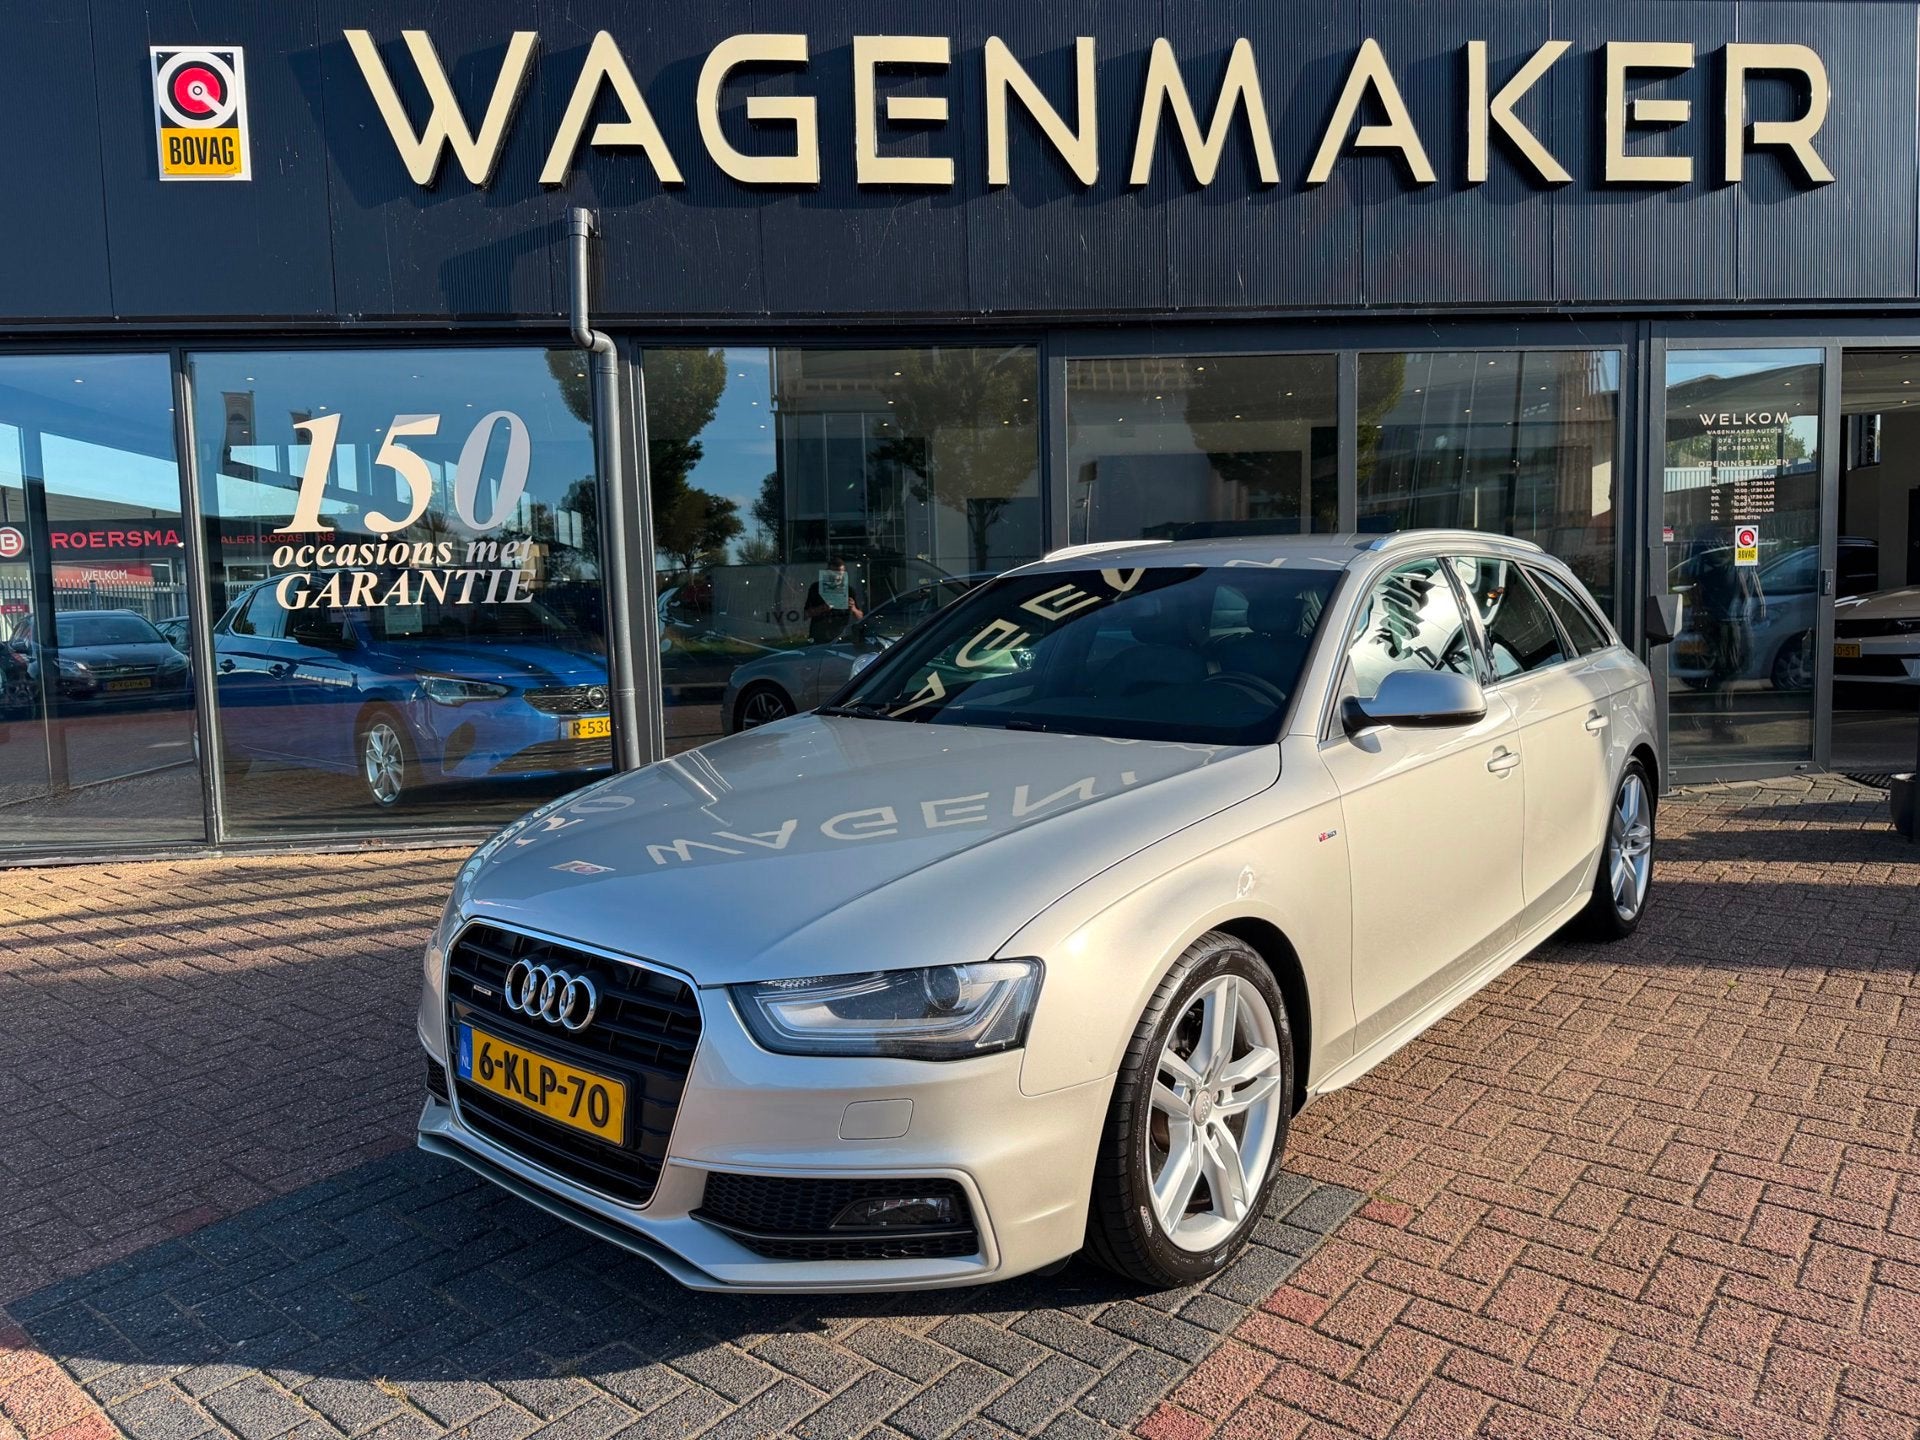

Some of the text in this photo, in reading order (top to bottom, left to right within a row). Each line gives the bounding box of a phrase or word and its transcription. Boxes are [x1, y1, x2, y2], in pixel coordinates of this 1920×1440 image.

[343, 29, 1836, 186] WAGENMAKER
[169, 136, 235, 165] BOVAG
[1699, 411, 1790, 426] WELKOM
[273, 410, 531, 533] 150
[1698, 459, 1790, 468] OPENINGSTIJDEN
[0, 529, 181, 551] B ROERSMA
[220, 532, 336, 544] ALER OCCASNS
[272, 534, 534, 568] occasions met
[81, 569, 128, 582] WELKOM
[275, 569, 537, 610] GARANTIE
[461, 1054, 471, 1070] NL
[478, 1041, 610, 1129] 6-KLP-70
